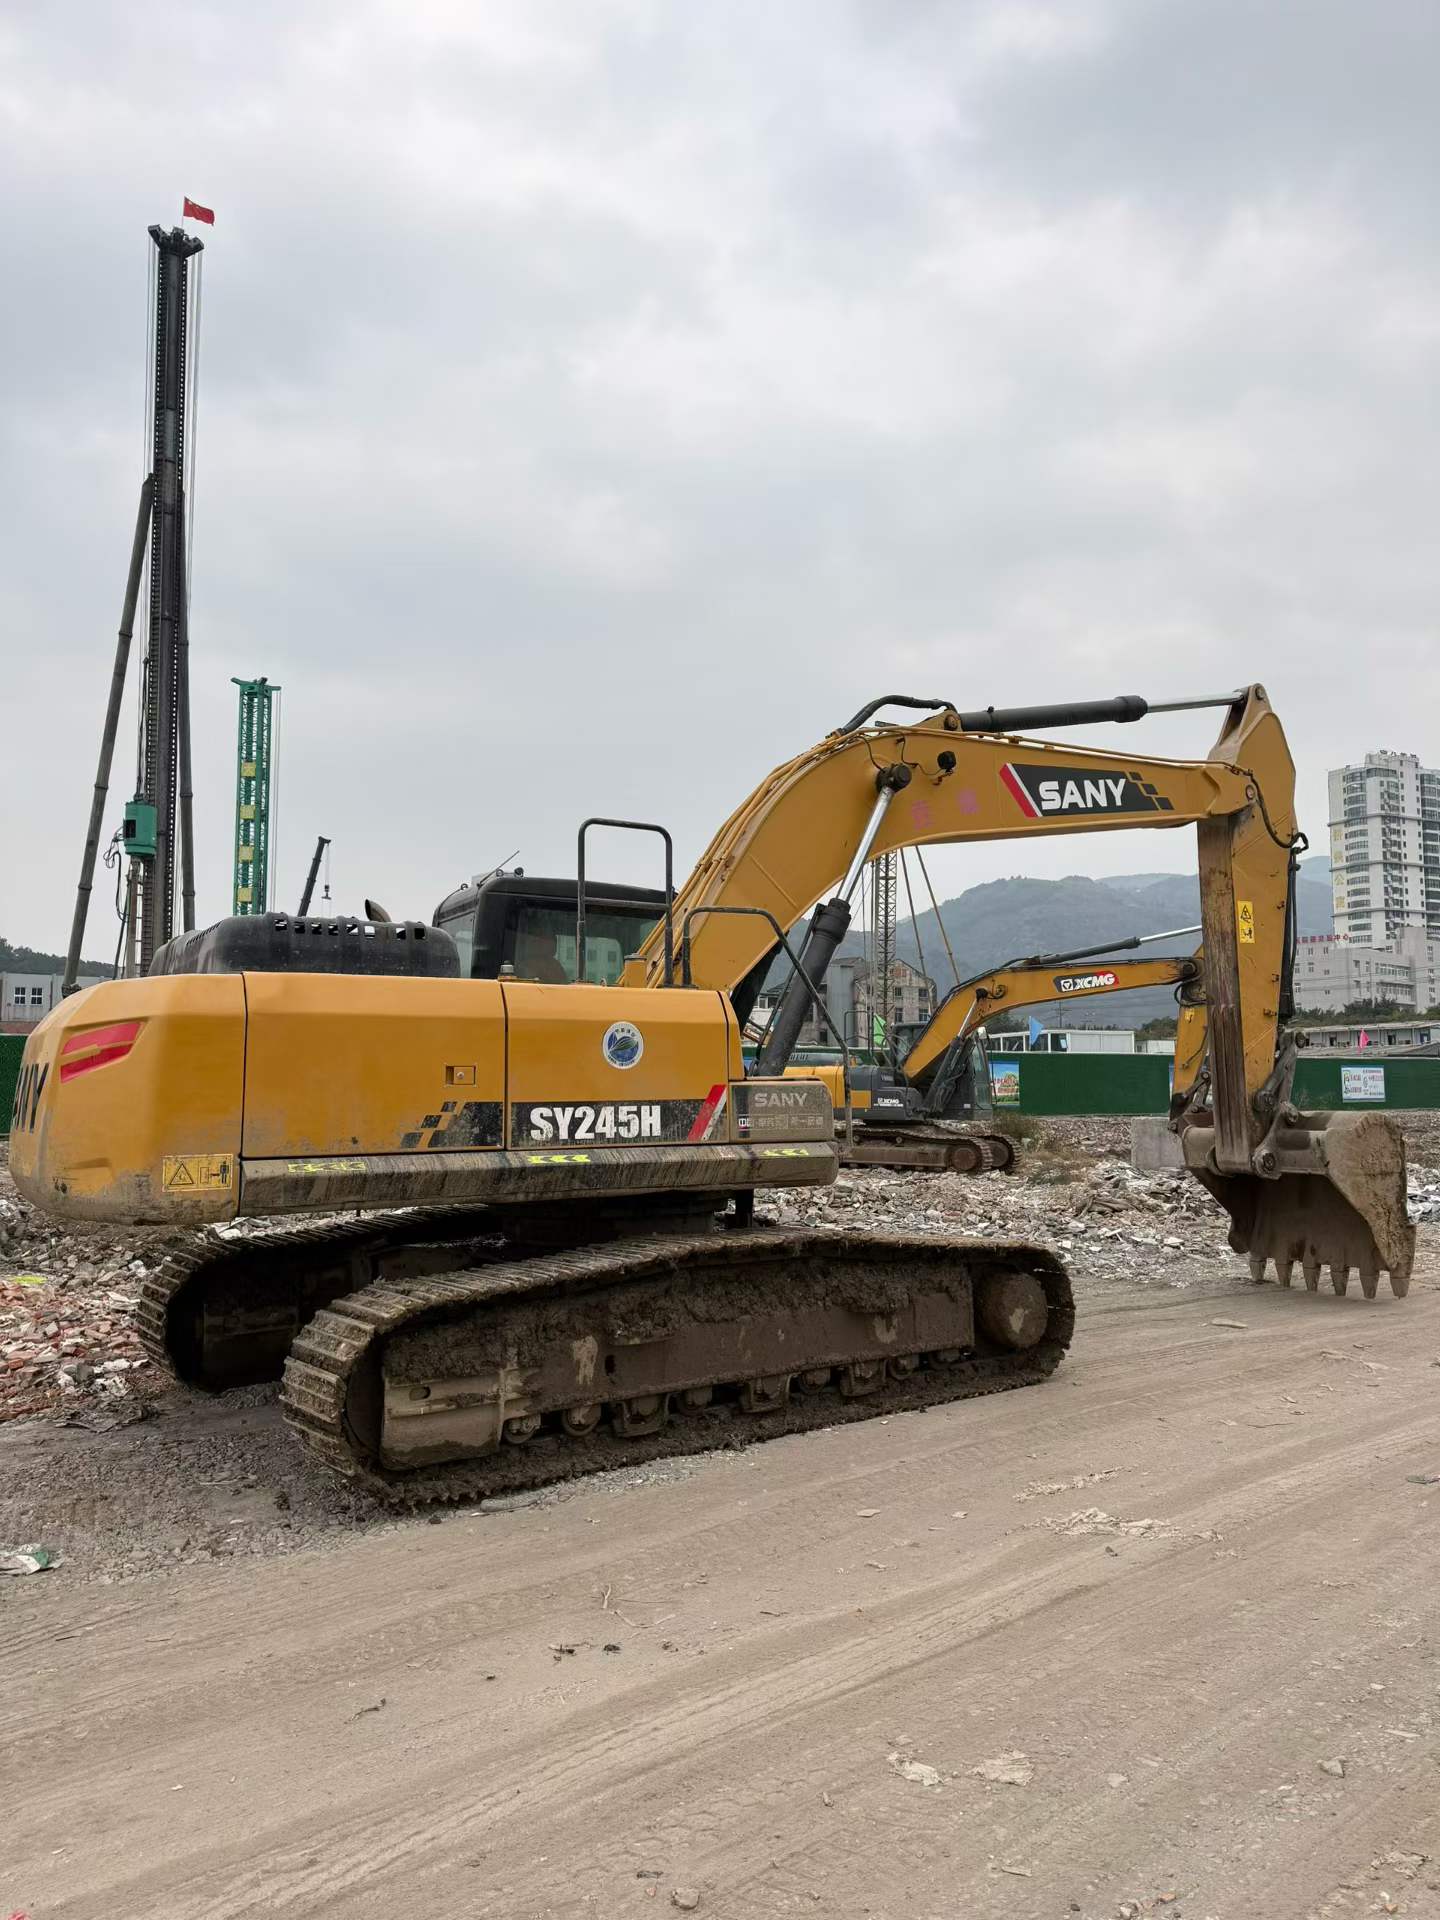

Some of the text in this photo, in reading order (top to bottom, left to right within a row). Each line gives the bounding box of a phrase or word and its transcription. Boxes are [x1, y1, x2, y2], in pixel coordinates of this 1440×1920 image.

[1039, 778, 1126, 810] SANY
[1073, 974, 1115, 990] XCMG
[754, 1092, 808, 1107] SANY
[529, 1105, 662, 1141] SY245H
